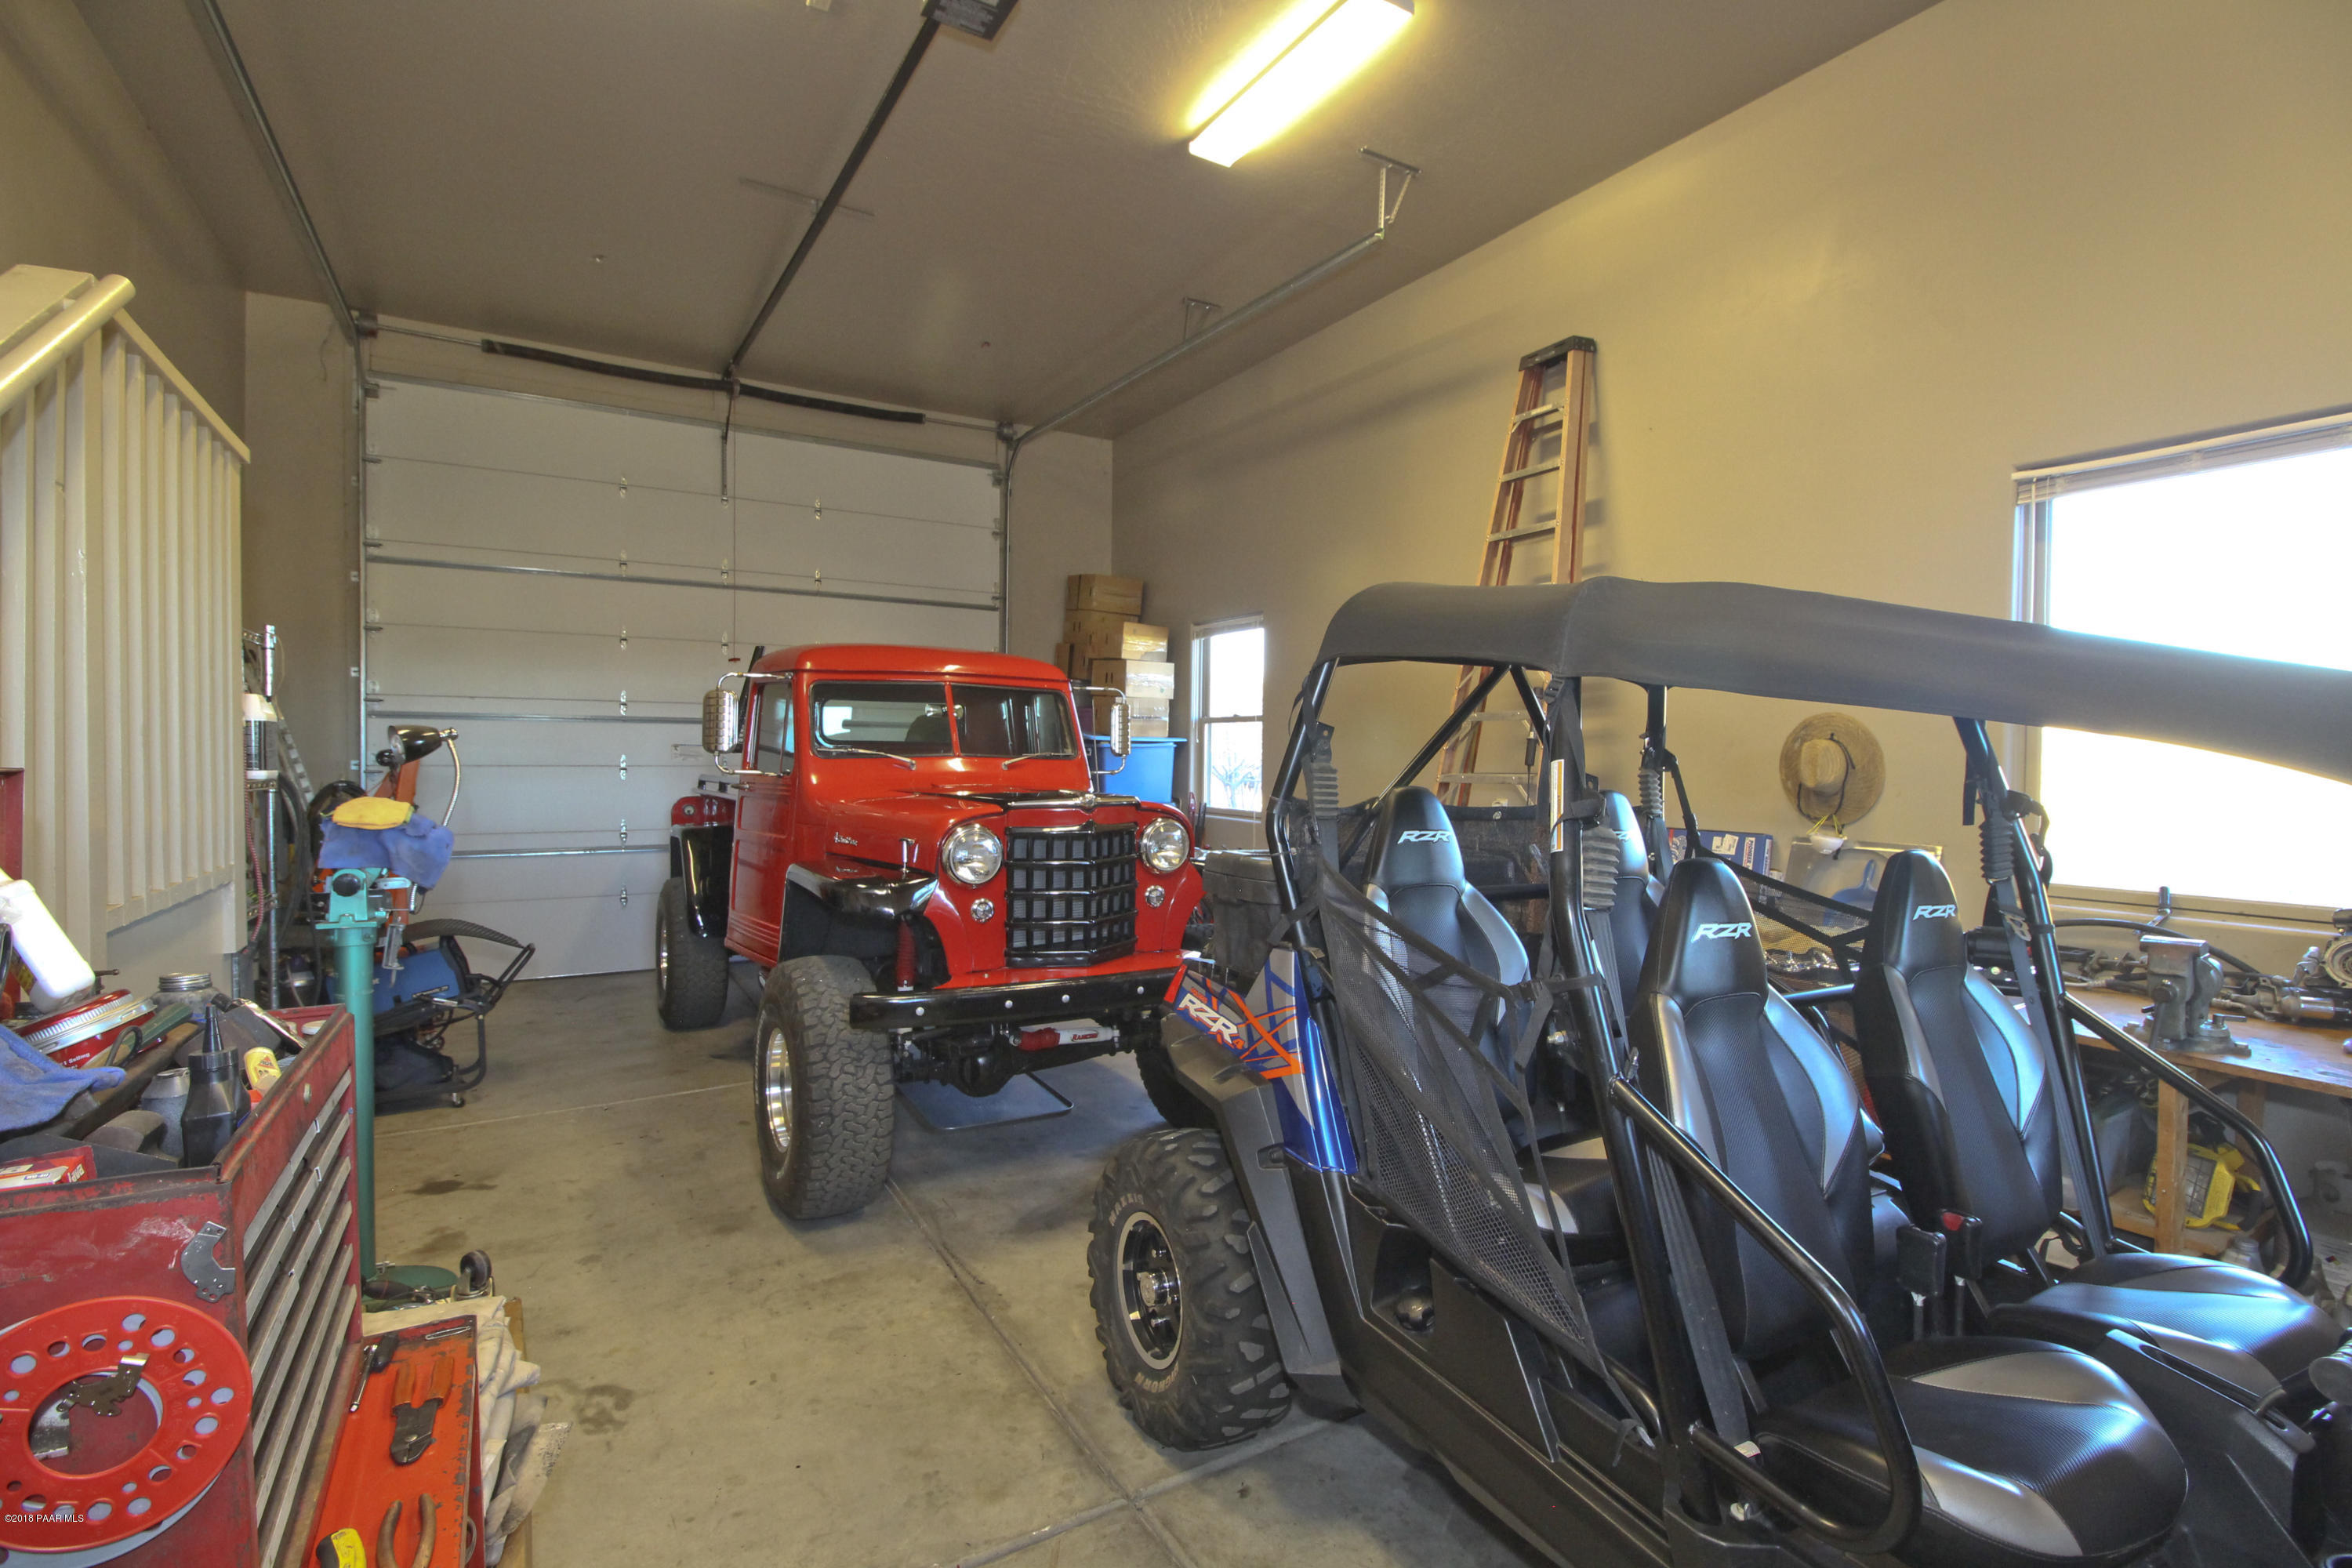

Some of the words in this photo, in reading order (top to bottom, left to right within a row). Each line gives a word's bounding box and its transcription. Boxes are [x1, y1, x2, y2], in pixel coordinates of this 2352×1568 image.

[1397, 830, 1450, 844] RZR
[1913, 904, 1956, 920] RZR
[1691, 922, 1752, 943] RZR
[1178, 993, 1239, 1045] RZR
[68, 1052, 90, 1065] Selling
